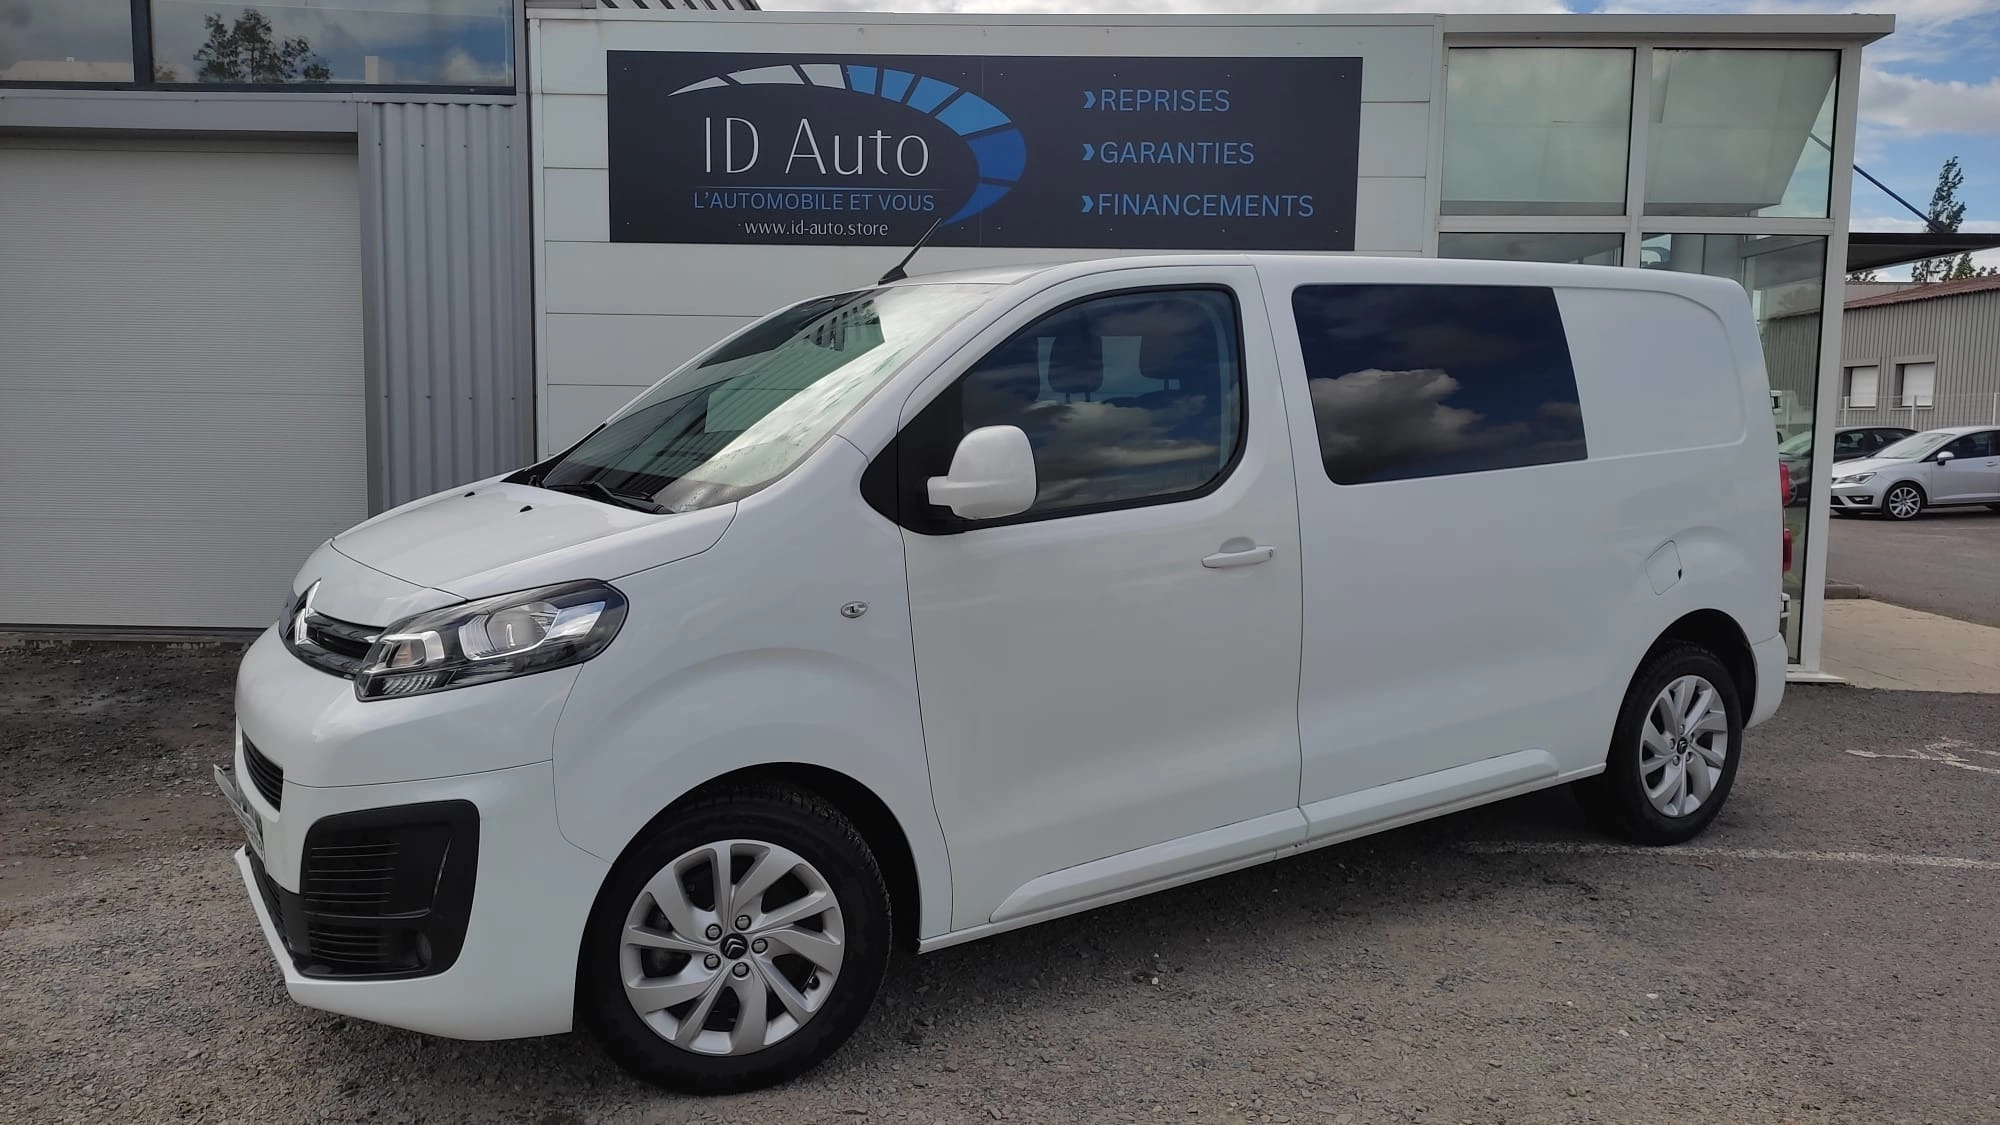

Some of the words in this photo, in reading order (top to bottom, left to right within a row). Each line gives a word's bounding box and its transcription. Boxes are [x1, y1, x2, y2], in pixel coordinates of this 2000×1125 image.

[1100, 89, 1231, 112] REPRISES
[704, 116, 760, 174] ID
[785, 117, 930, 177] Auto
[1100, 141, 1255, 165] GARANTIES
[849, 193, 874, 211] ET
[878, 194, 936, 212] VOUS
[1098, 193, 1315, 217] FINANCEMENTS
[744, 219, 890, 237] www.id-auto.store
